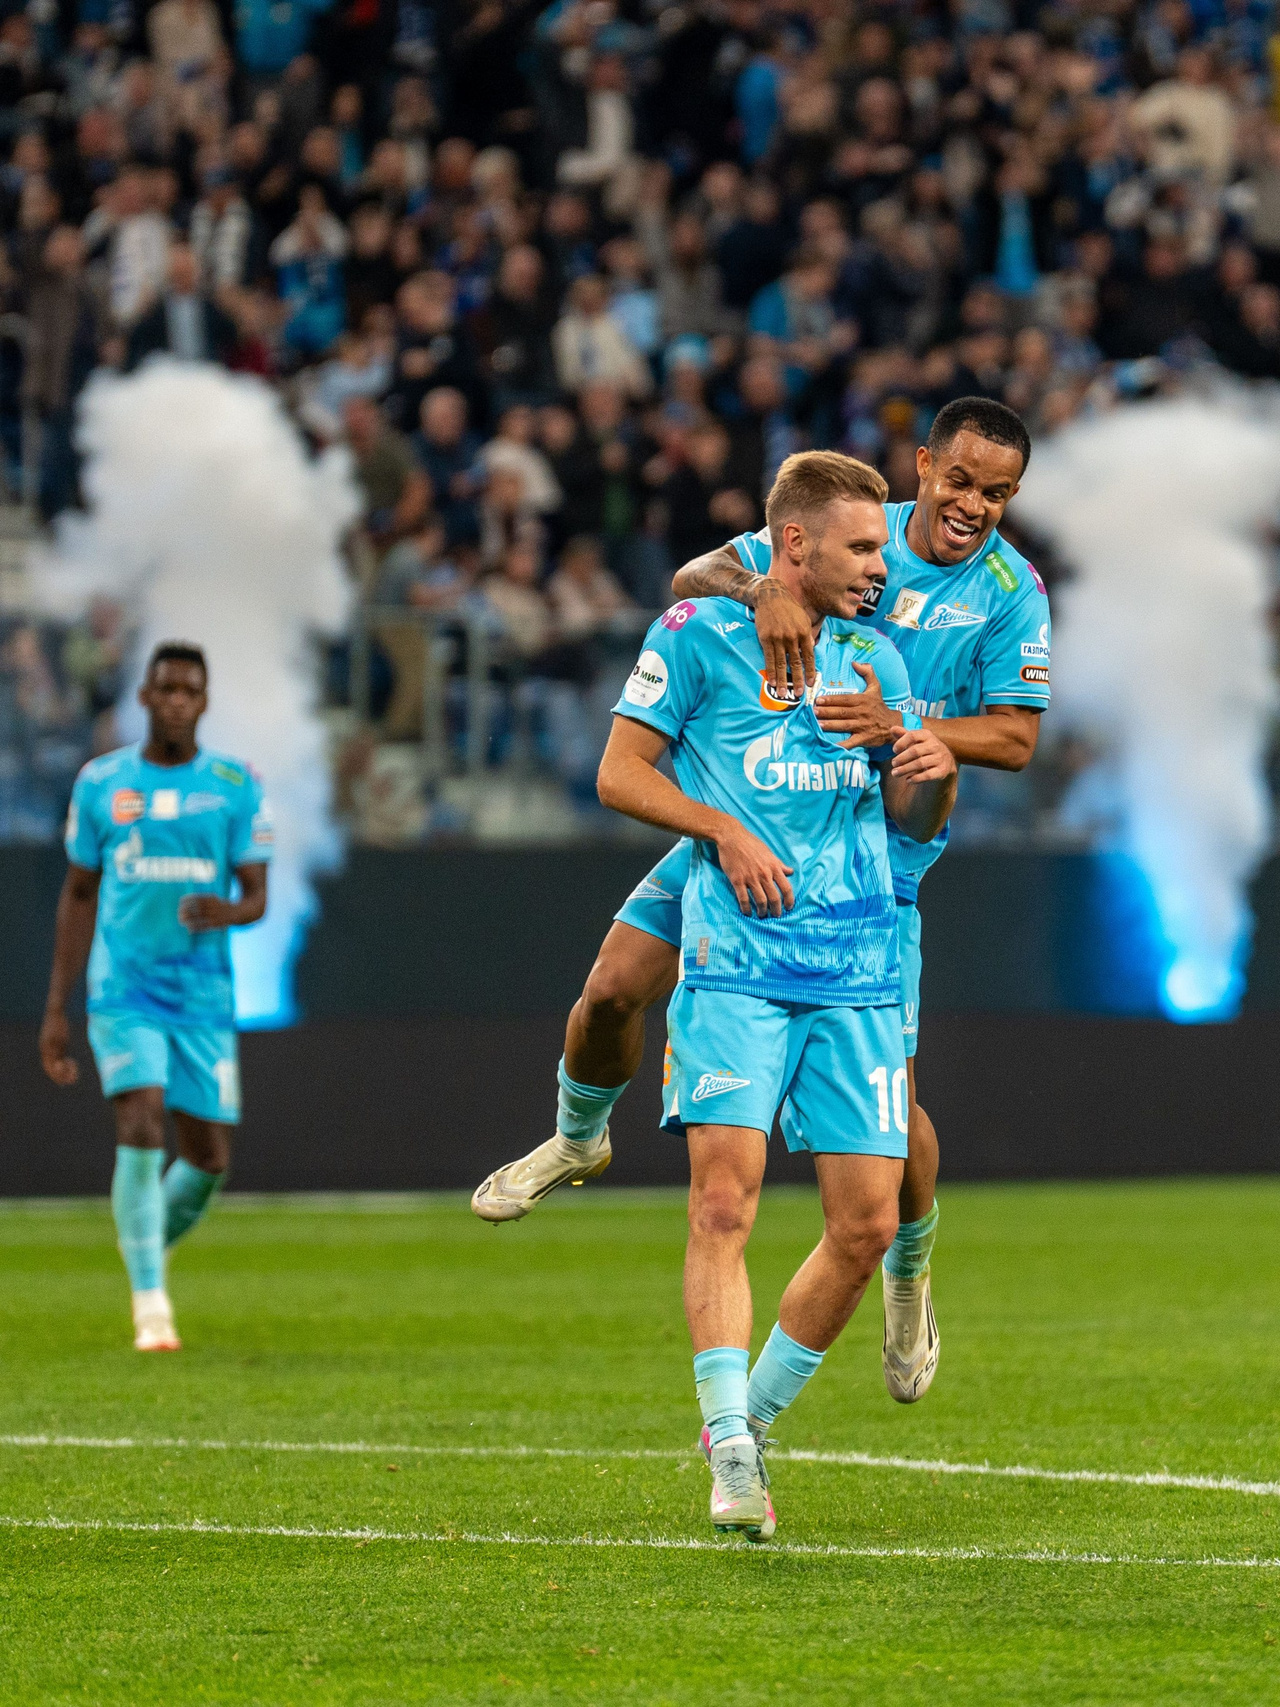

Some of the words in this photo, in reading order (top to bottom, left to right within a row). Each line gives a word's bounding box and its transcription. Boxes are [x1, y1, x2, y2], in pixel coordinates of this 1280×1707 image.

[1023, 645, 1050, 657] ГАЗПРО
[640, 670, 664, 684] МИР
[1025, 668, 1049, 681] WINL
[868, 1065, 908, 1134] 10
